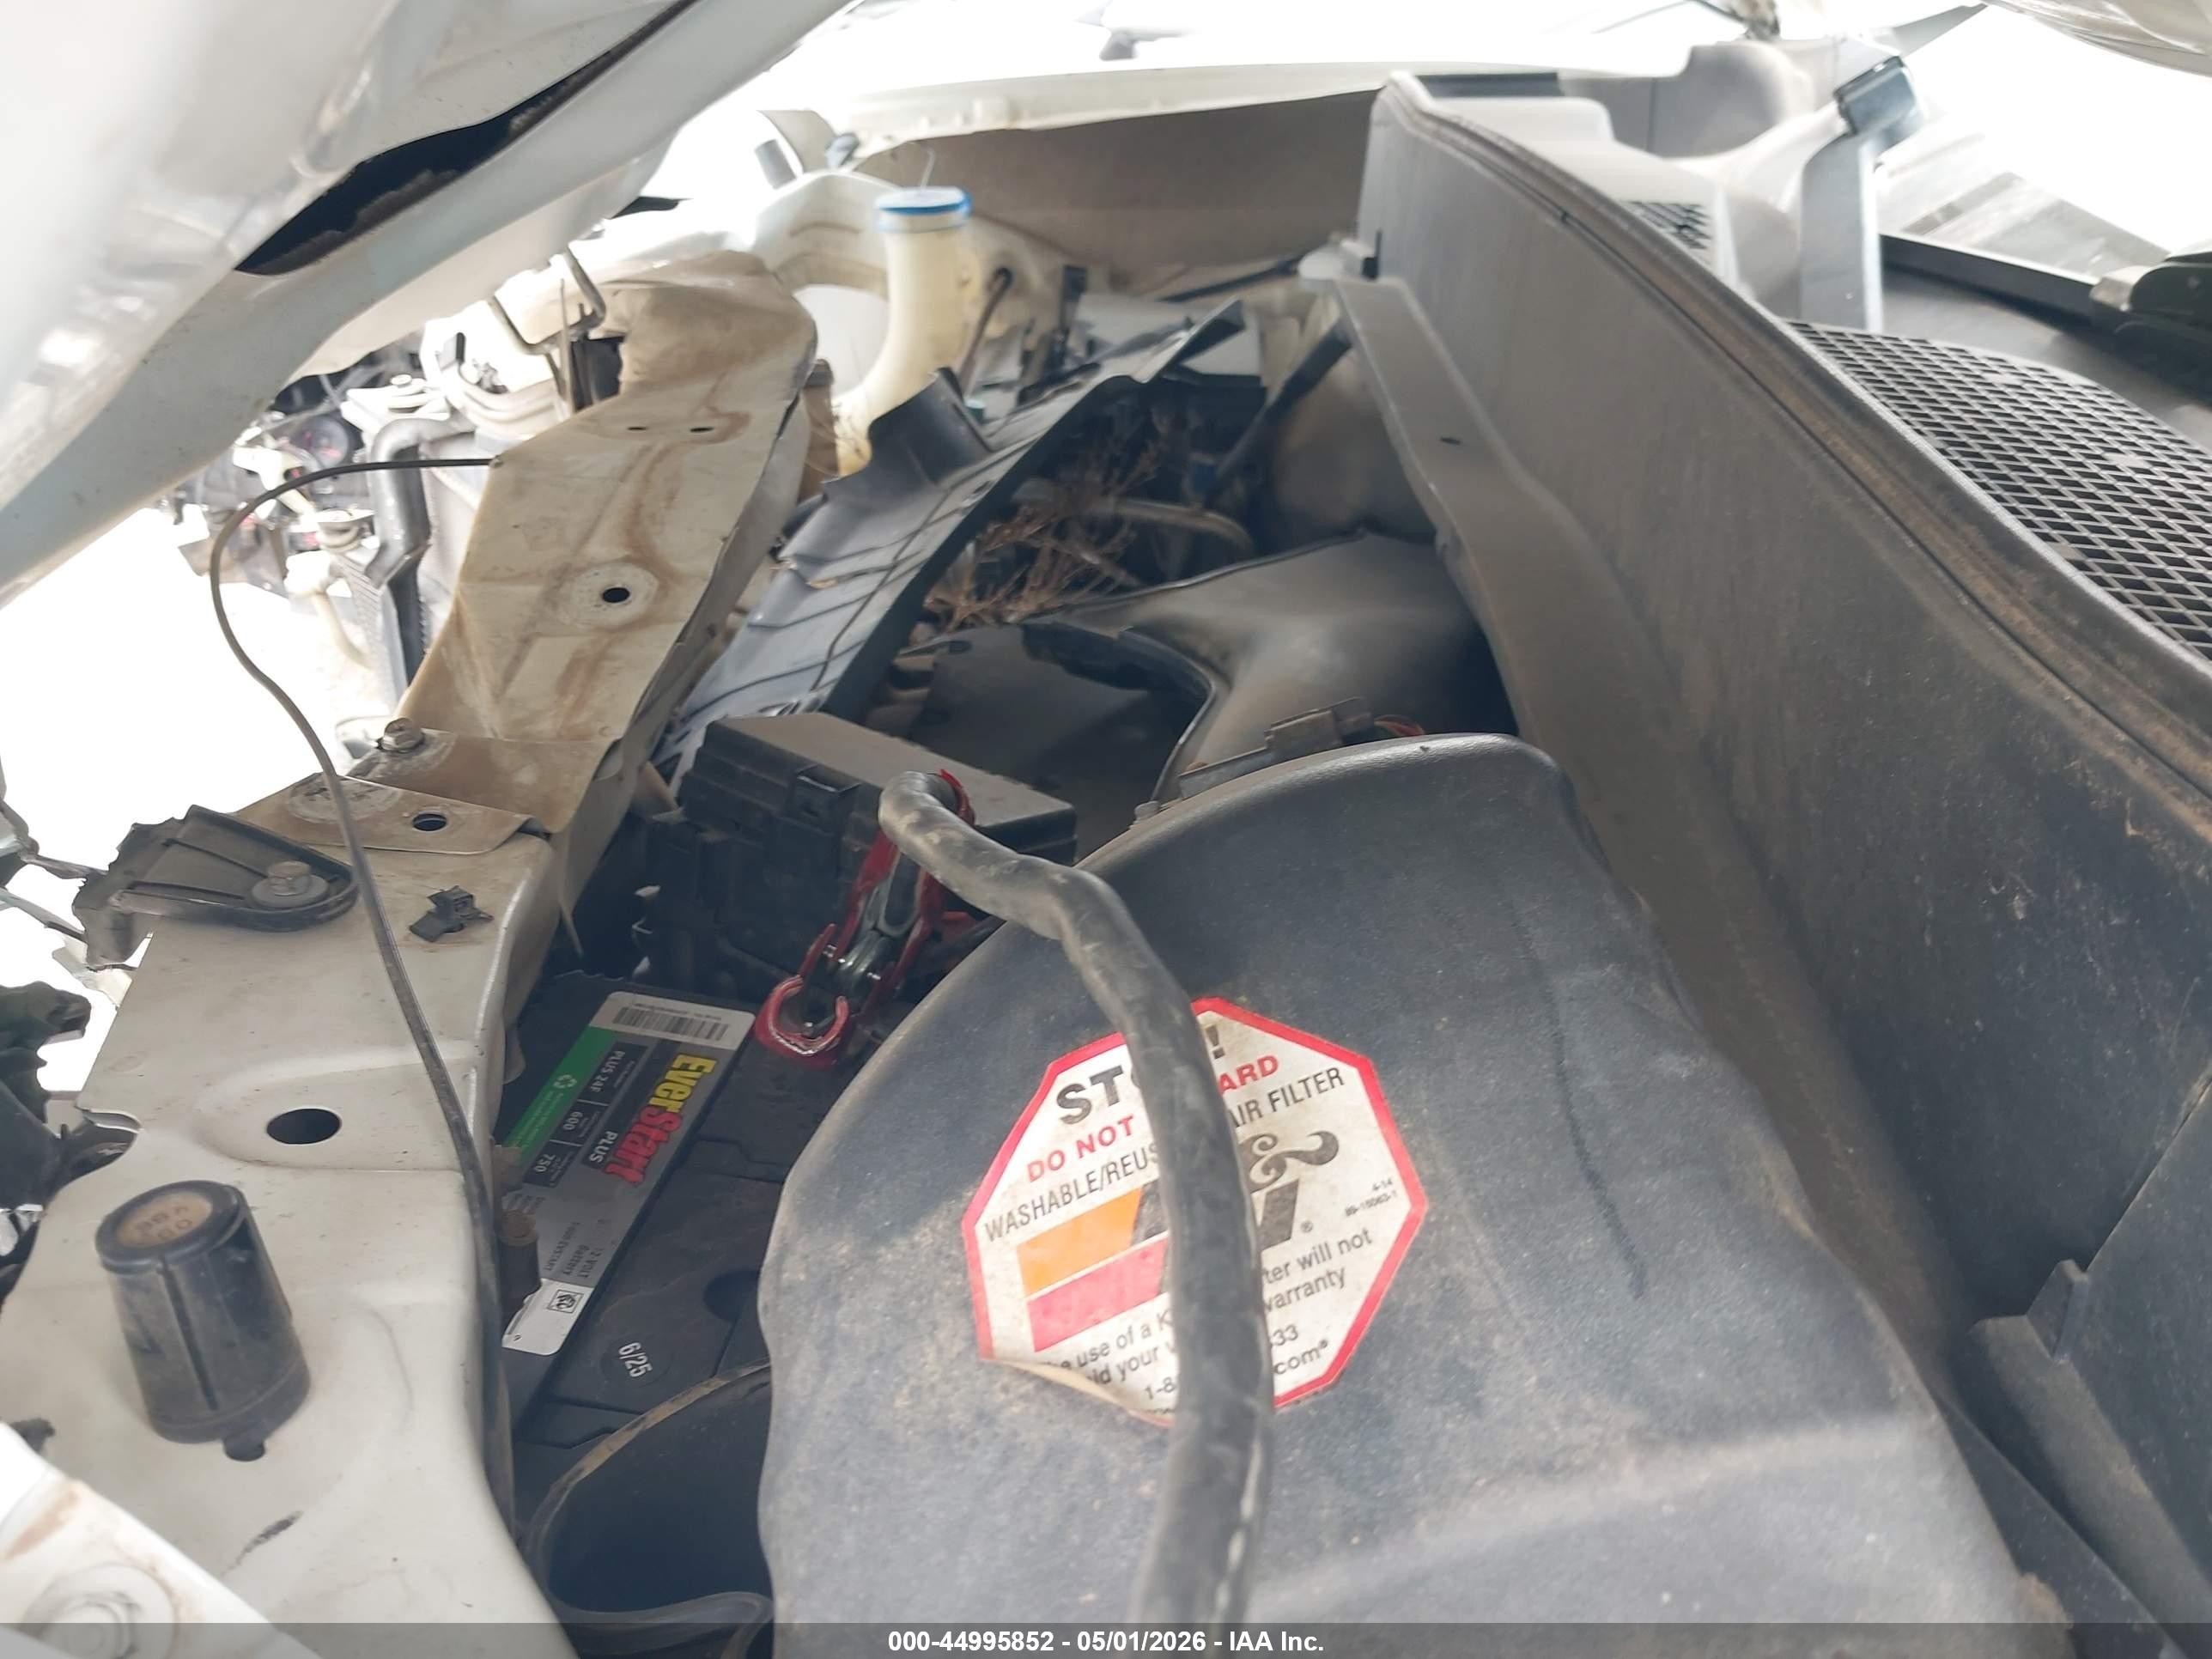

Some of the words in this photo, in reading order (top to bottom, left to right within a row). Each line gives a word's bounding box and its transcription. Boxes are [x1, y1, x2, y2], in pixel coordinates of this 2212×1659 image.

[602, 1050, 625, 1073] PLUS
[562, 1111, 584, 1131] 600
[605, 1053, 718, 1184] EverStart
[533, 1153, 556, 1173] 750
[589, 1130, 619, 1164] PLUS
[984, 1142, 1160, 1242] WASHABLE/REUS
[1267, 1066, 1346, 1113] FILTER
[1027, 1149, 1066, 1183] DO
[1075, 1115, 1135, 1159] NOT
[1077, 1342, 1110, 1368] use
[1116, 1326, 1134, 1349] of
[1140, 1323, 1152, 1339] a
[1297, 1243, 1332, 1271] will
[1338, 1229, 1373, 1255] not
[618, 1341, 653, 1377] 6/25
[1116, 1346, 1158, 1382] your
